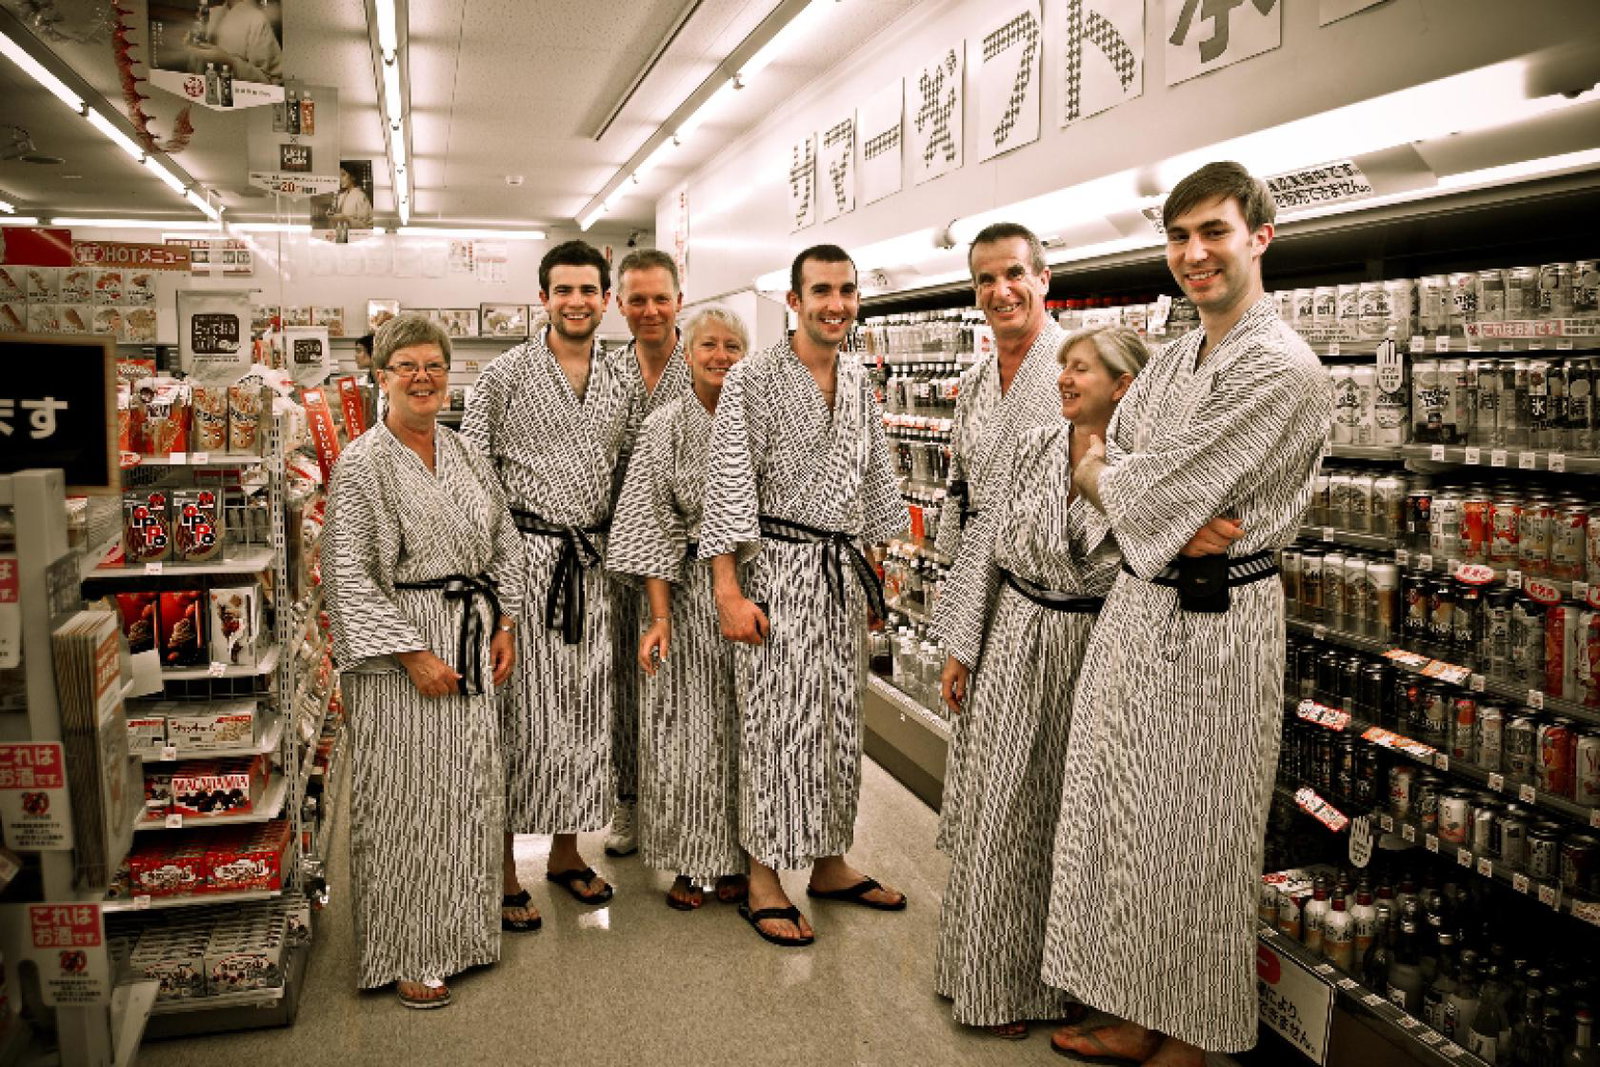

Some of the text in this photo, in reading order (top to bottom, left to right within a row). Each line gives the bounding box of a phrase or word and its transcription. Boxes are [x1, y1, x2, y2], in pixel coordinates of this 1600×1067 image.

[105, 246, 187, 264] HOTメニュー
[32, 907, 93, 926] これは
